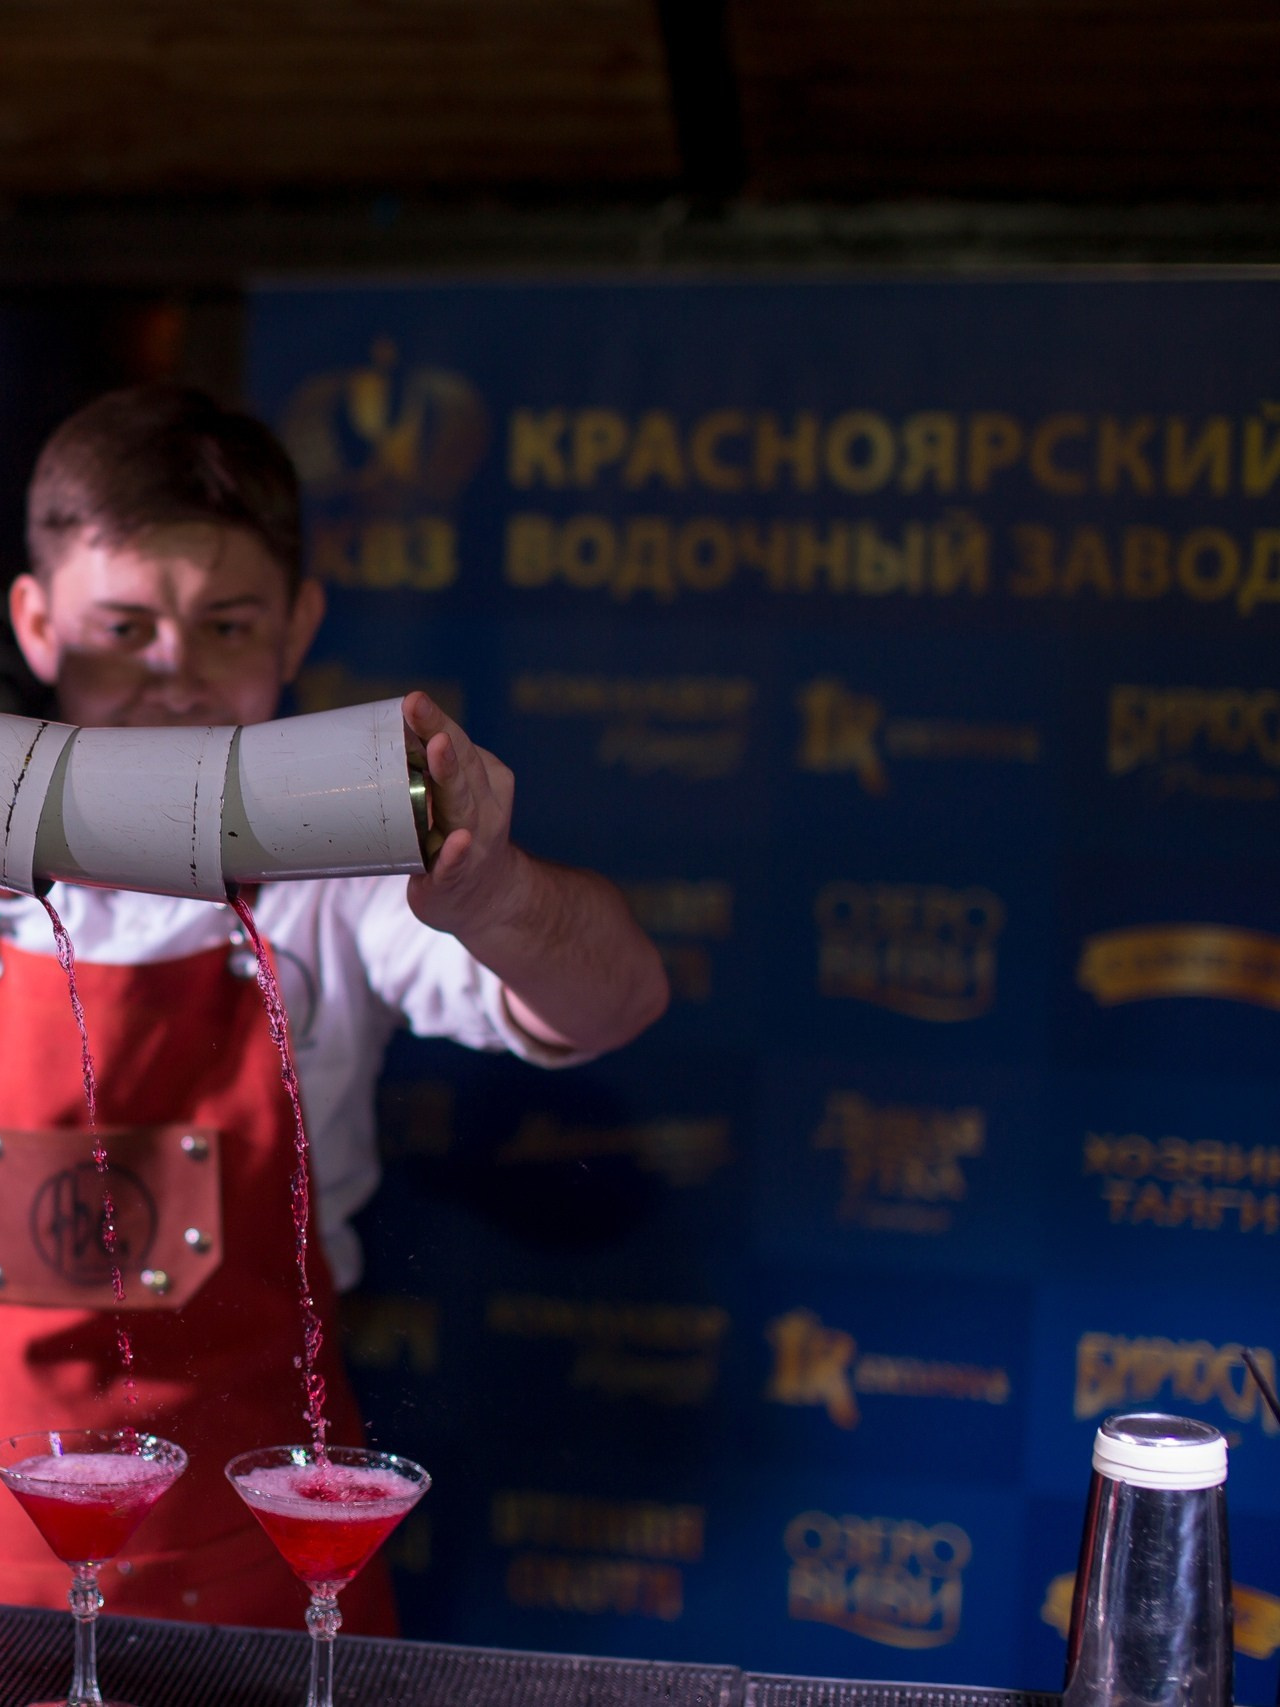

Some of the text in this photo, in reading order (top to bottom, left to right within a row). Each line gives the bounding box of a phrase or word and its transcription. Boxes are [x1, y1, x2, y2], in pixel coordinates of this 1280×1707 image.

[510, 400, 1280, 498] КРАСНОЯРСКИЙ
[507, 505, 1280, 617] ВОДОЧНЫЙ ЗАВОД
